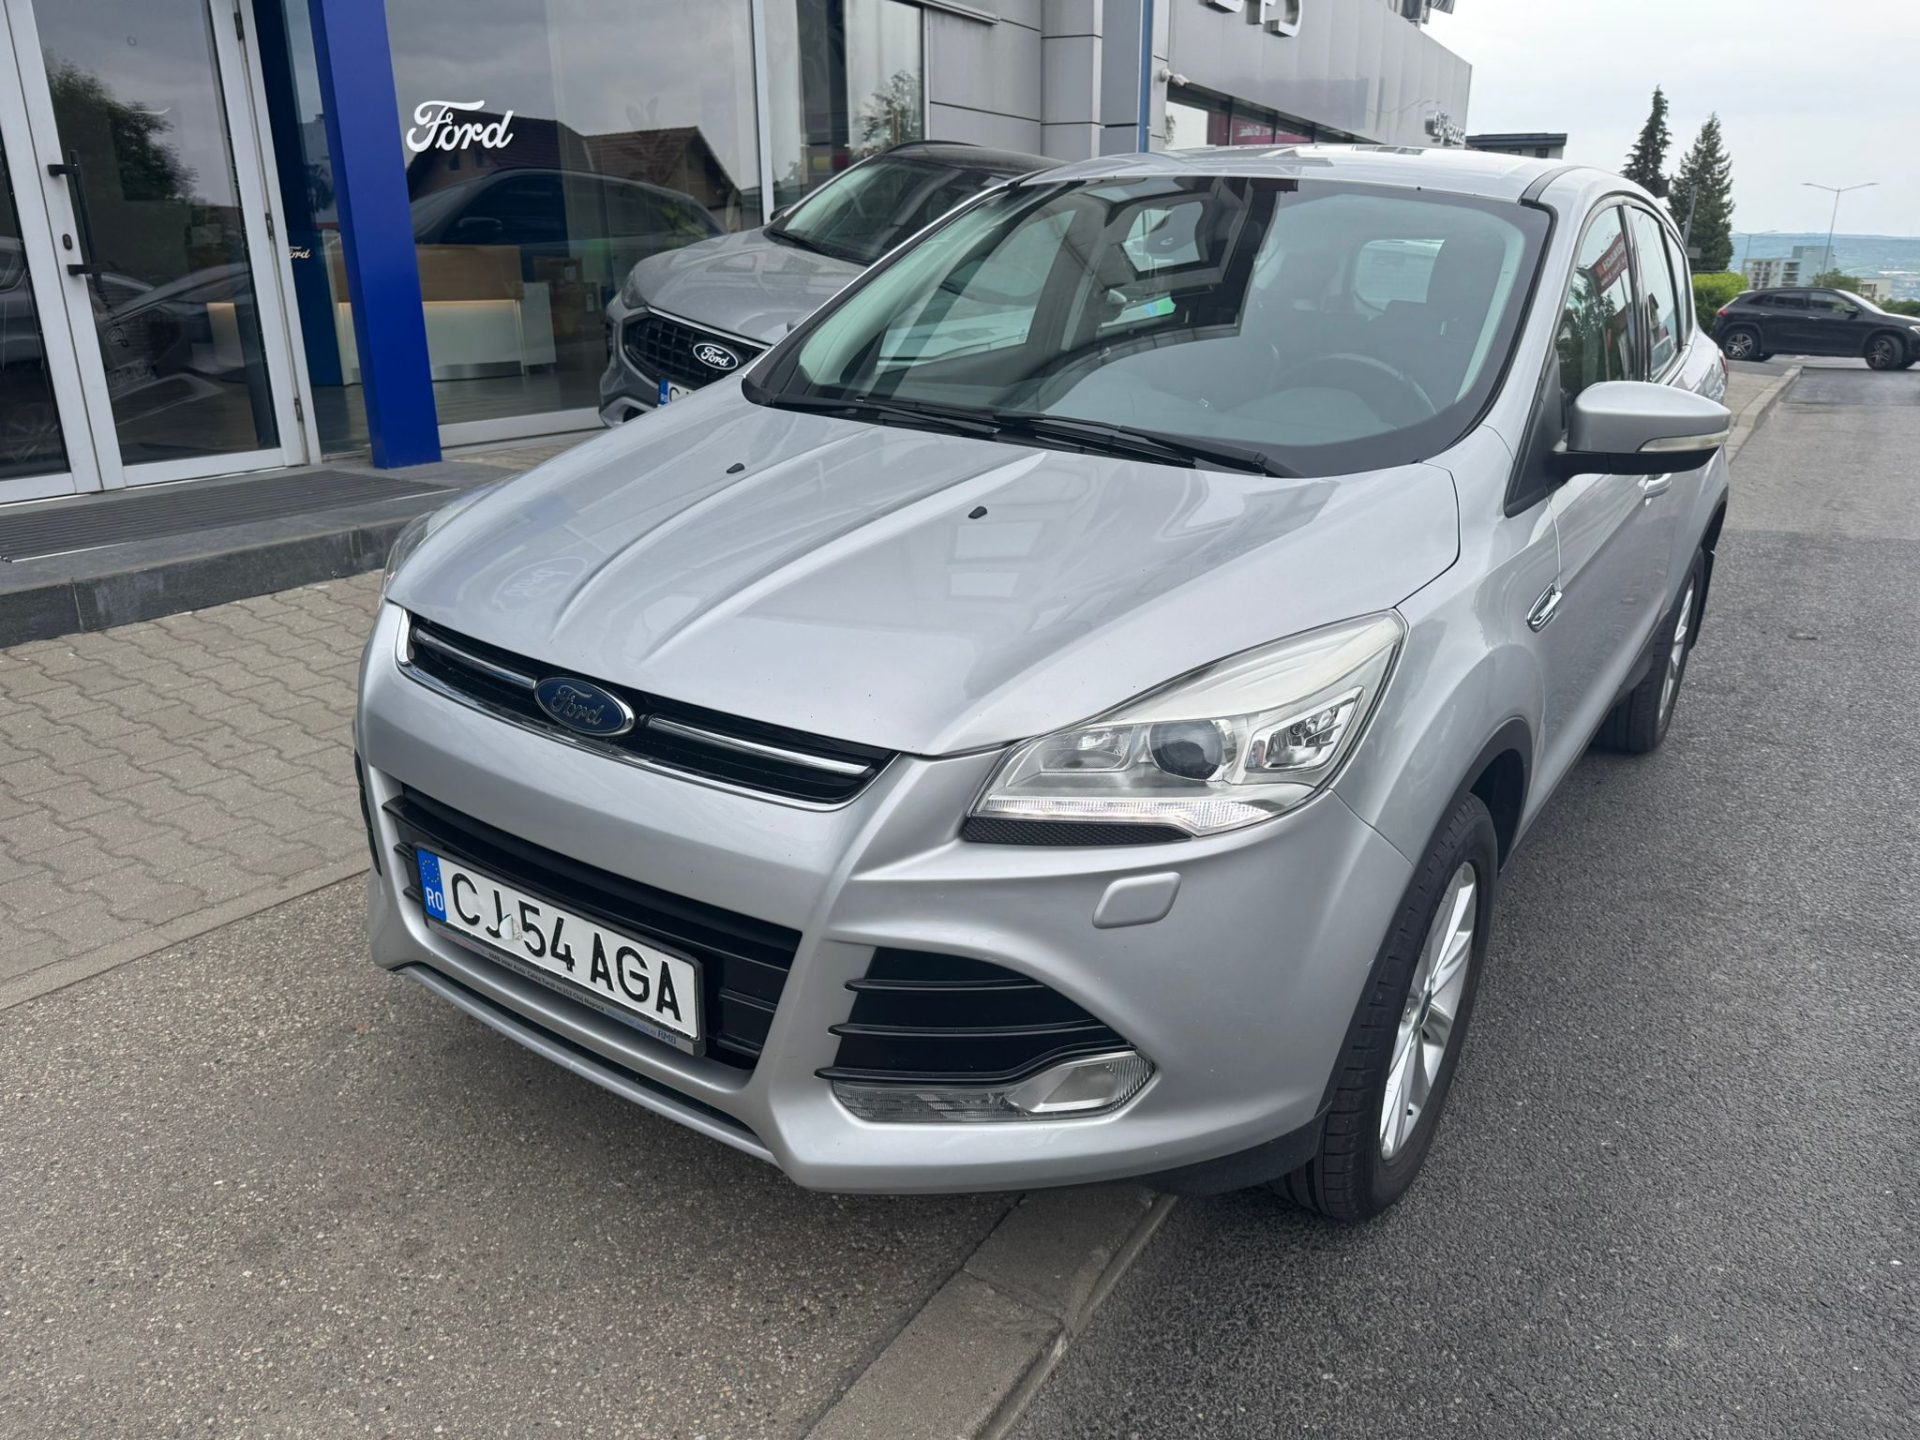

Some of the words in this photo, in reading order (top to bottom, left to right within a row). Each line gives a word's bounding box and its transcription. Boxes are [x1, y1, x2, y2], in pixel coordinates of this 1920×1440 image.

[405, 99, 515, 153] Ford
[700, 346, 731, 367] Ford
[551, 684, 605, 726] Ford
[426, 887, 445, 912] RO
[451, 872, 501, 938] CJ
[518, 899, 575, 973] 54
[590, 931, 682, 1022] AGA
